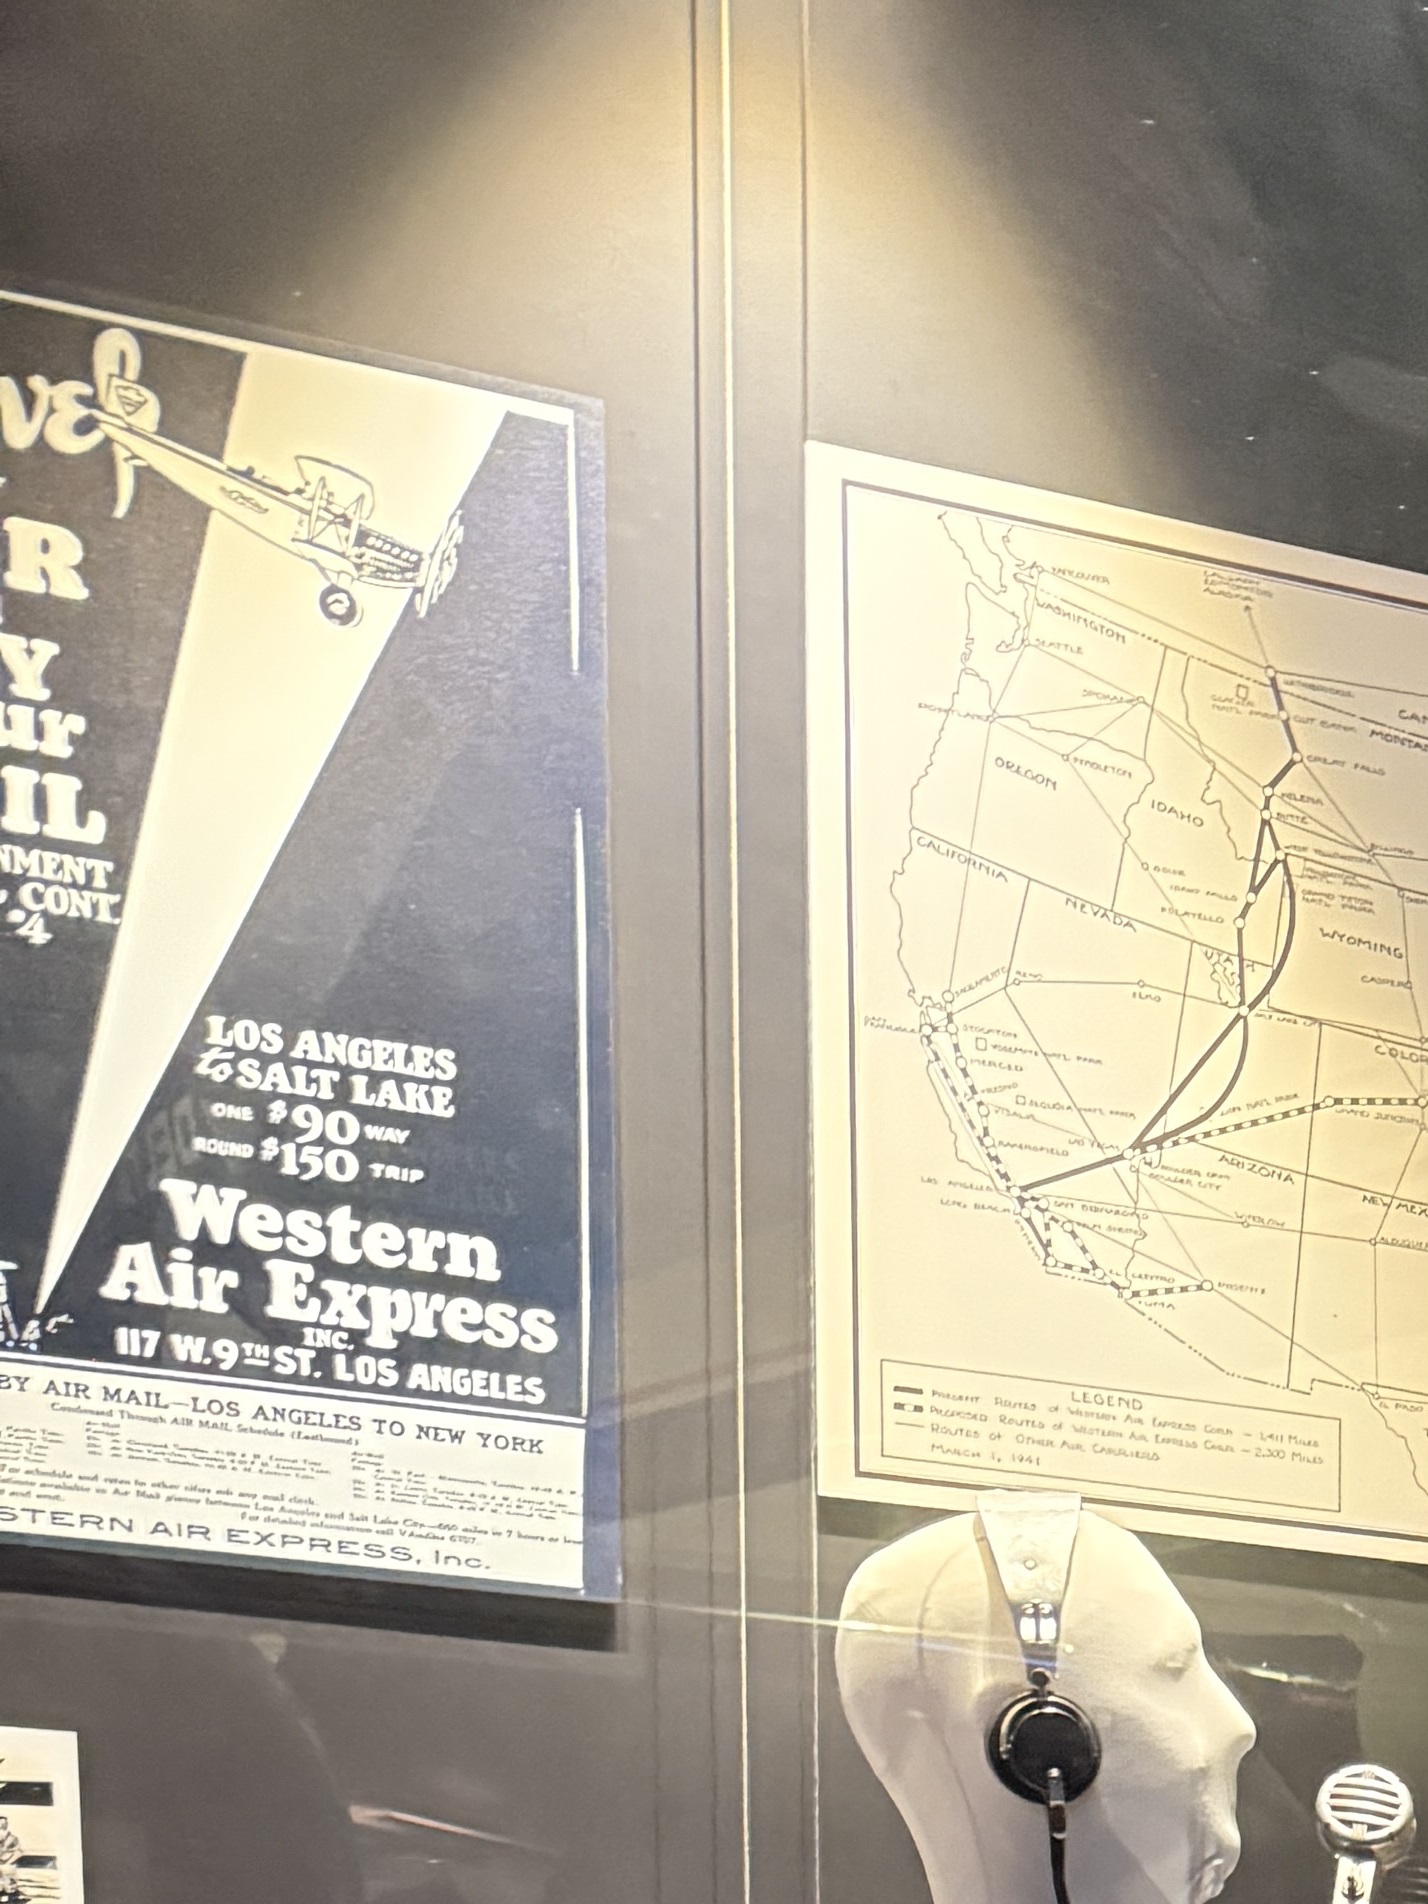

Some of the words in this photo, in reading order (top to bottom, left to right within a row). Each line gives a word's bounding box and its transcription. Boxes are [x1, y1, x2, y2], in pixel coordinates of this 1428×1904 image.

[994, 756, 1057, 791] OREGON
[1150, 798, 1205, 829] IDAHO
[916, 835, 1009, 883] CALIFORNIA
[1064, 896, 1138, 933] NEVADA
[1319, 927, 1404, 960] WYOMING
[204, 1015, 284, 1054] LOS
[289, 1029, 458, 1081] ANGELES
[235, 1057, 341, 1100] SALT
[348, 1074, 455, 1118] LAKE
[209, 1102, 254, 1121] ONE
[362, 1124, 412, 1144] WAY
[191, 1136, 254, 1159] ROUND
[259, 1135, 360, 1182] $150
[368, 1162, 425, 1183] TRIP
[1218, 1154, 1295, 1186] ARIZONA
[1362, 1193, 1392, 1211] NEW
[159, 1177, 502, 1282] Western
[99, 1240, 240, 1314] Air
[263, 1257, 559, 1354] Express
[302, 1327, 354, 1351] INC.
[114, 1327, 161, 1358] 117
[273, 1345, 322, 1379] ST.
[332, 1354, 399, 1388] LOS
[406, 1363, 546, 1405] ANGELES
[42, 1379, 92, 1400] AIR
[251, 1404, 362, 1431] ANGELES
[371, 1417, 406, 1437] TO
[415, 1423, 467, 1445] NEW
[475, 1431, 545, 1454] YORK
[1070, 1390, 1144, 1412] LEGEND
[149, 1521, 212, 1542] AIR
[432, 1549, 491, 1571] Inc.
